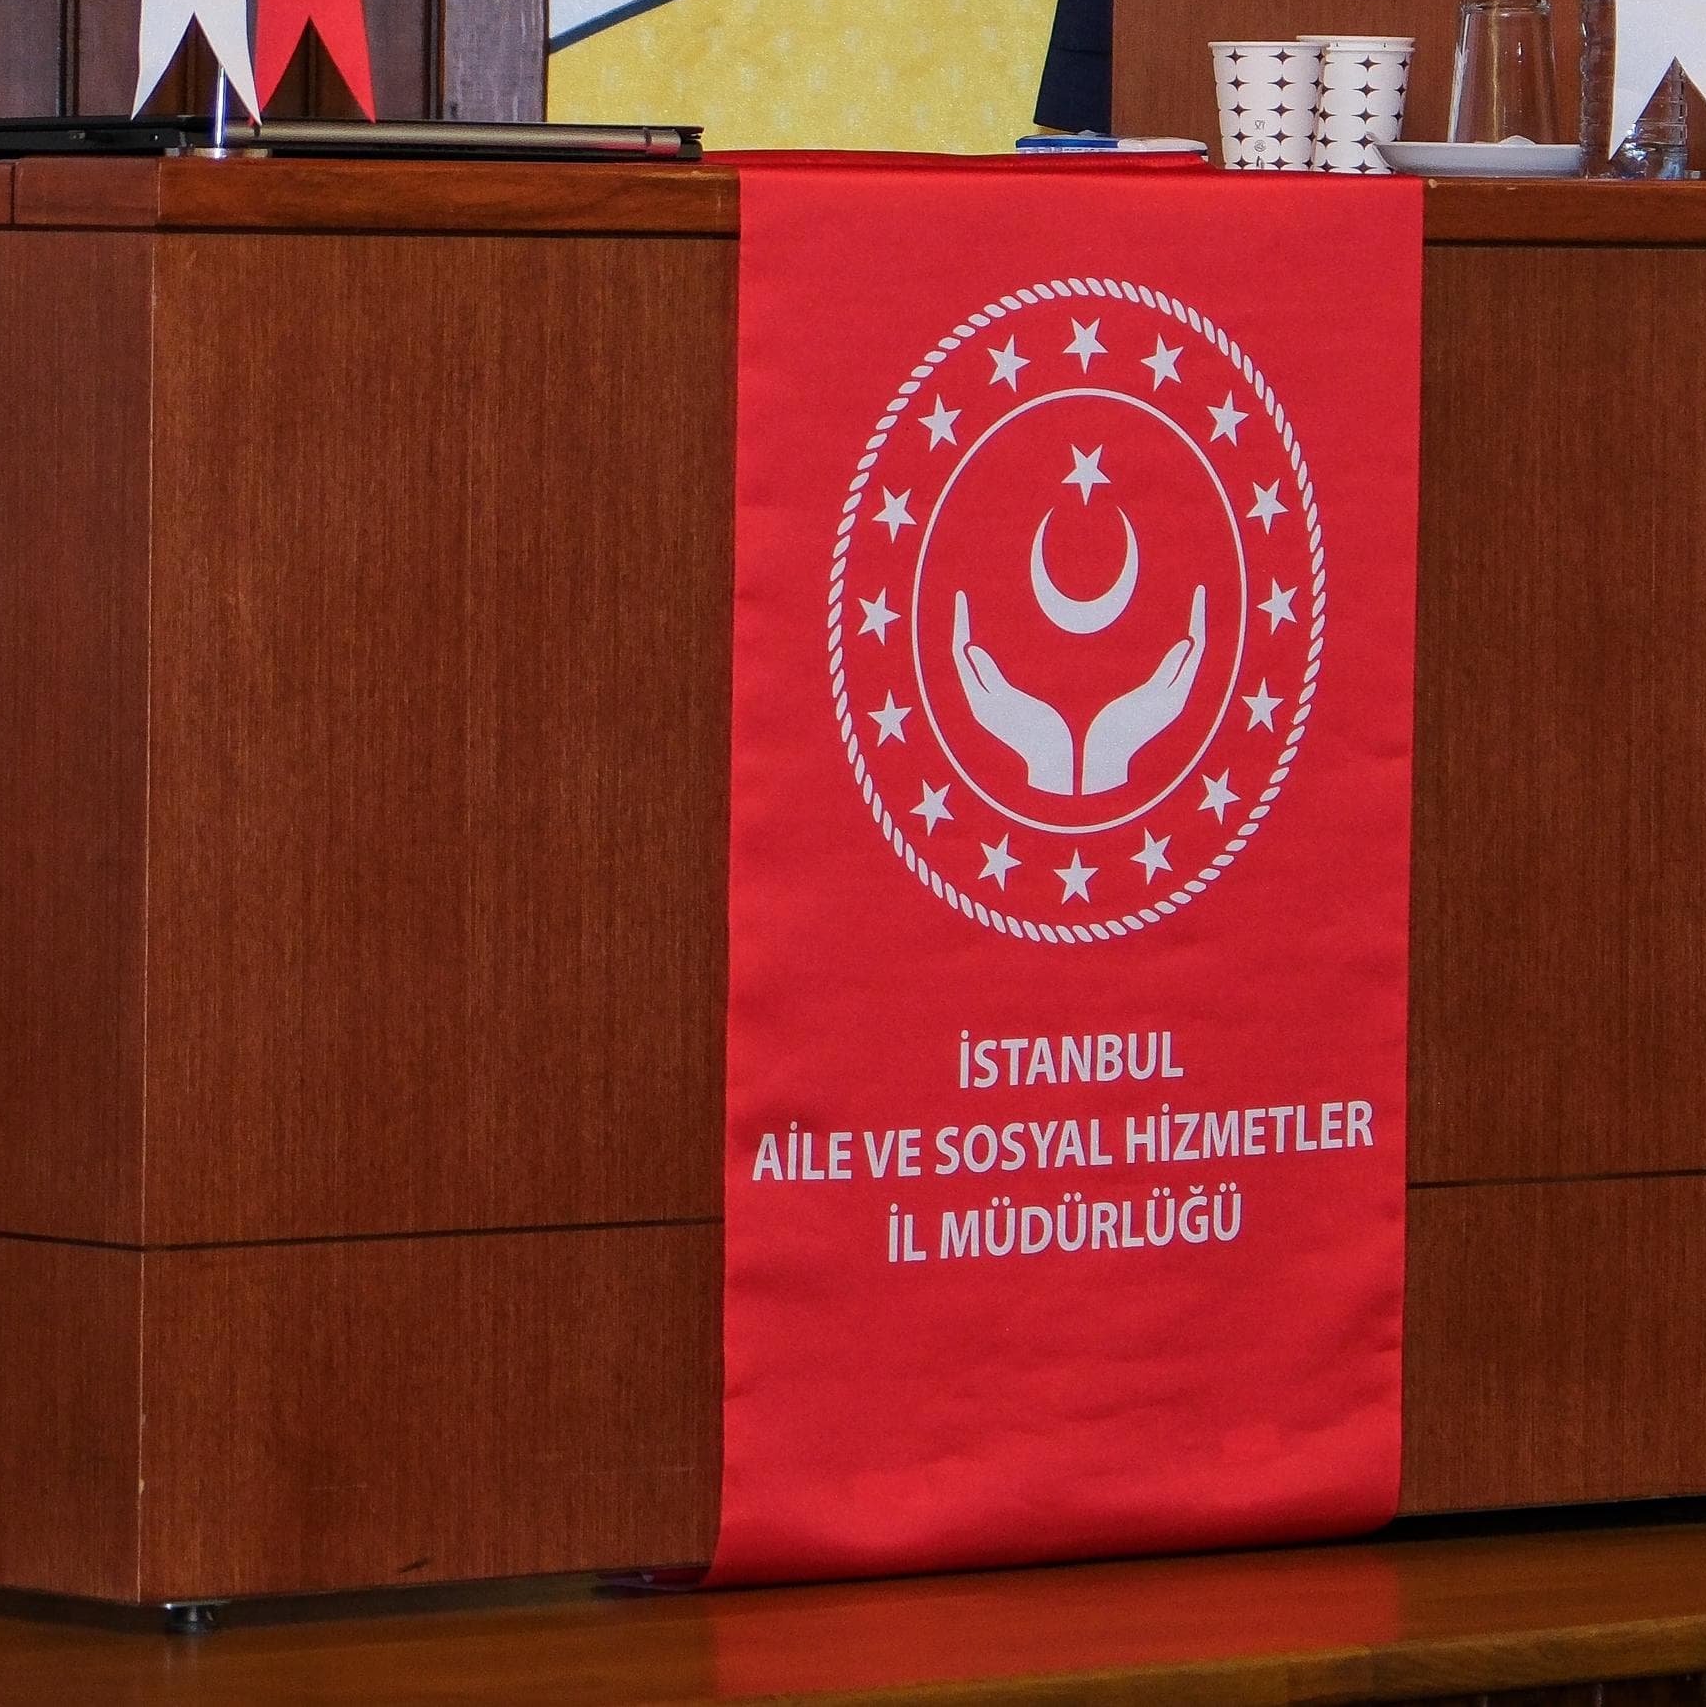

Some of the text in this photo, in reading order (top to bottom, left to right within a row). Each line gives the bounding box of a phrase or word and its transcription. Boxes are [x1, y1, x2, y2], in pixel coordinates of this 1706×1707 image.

[959, 1030, 1183, 1089] İSTANBUL
[753, 1100, 1374, 1181] AİLE VE SOSYAL HİZMETLER
[888, 1182, 1243, 1263] İL MÜDÜRLÜĞÜ
